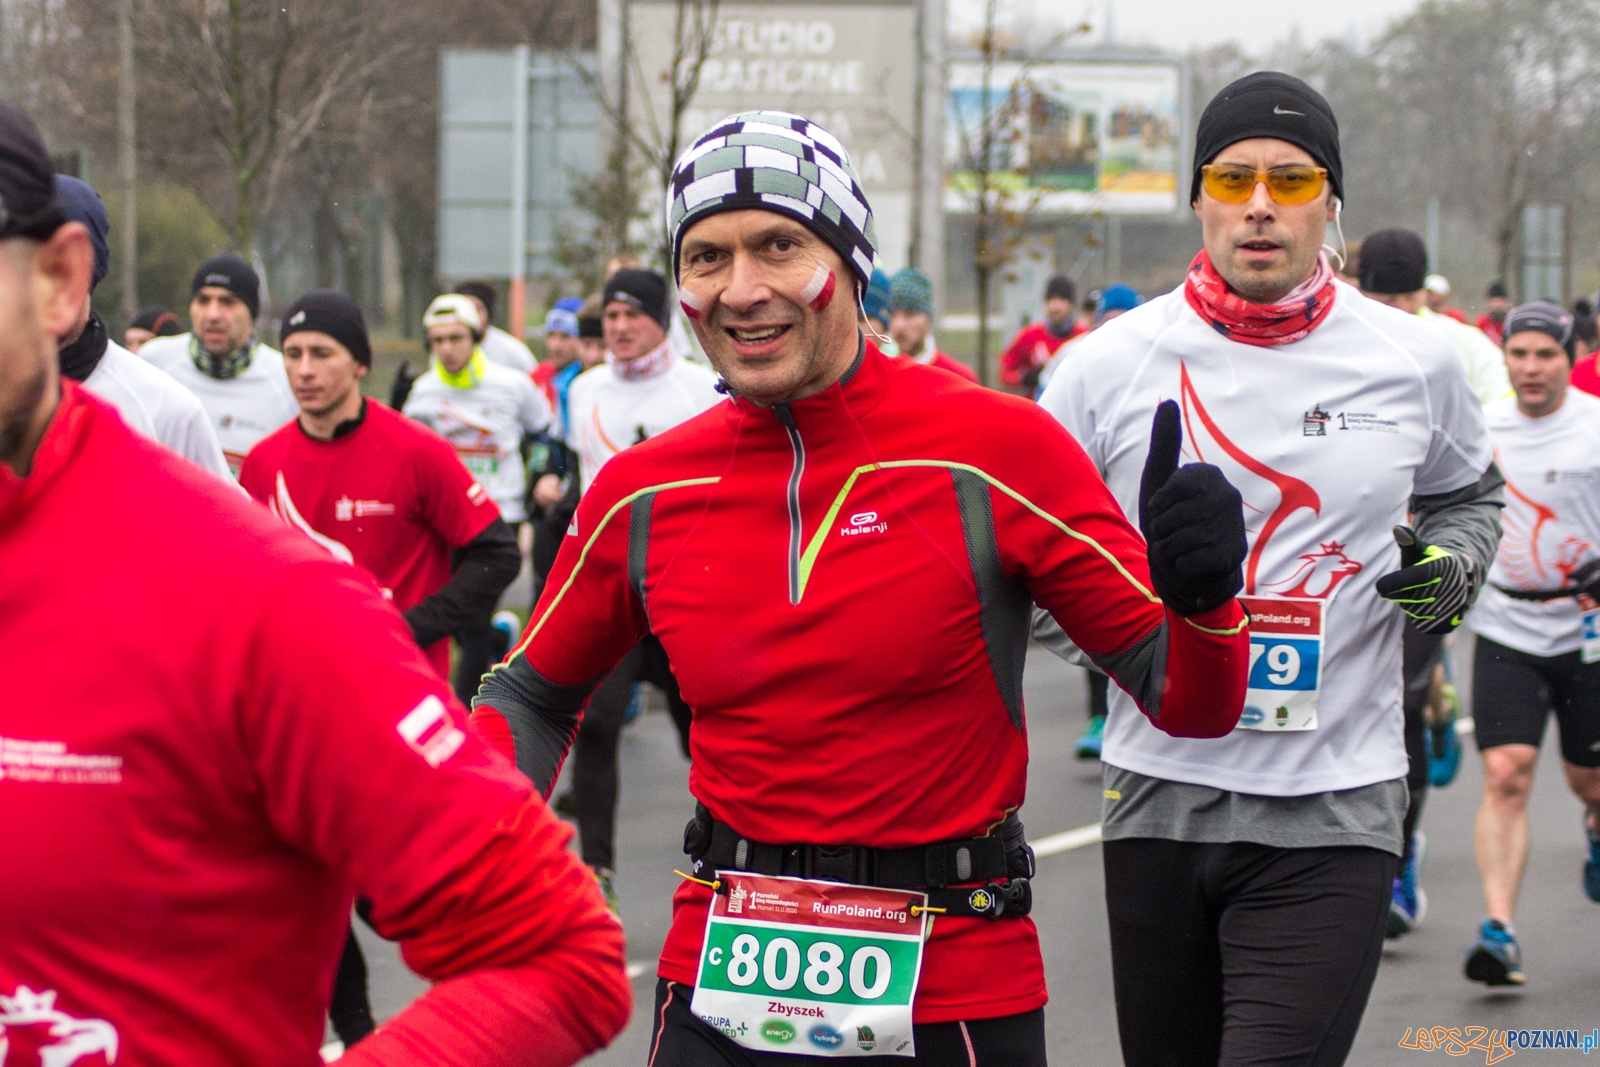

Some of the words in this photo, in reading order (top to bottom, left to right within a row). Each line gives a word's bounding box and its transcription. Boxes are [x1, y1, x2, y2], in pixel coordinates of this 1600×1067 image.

[711, 20, 835, 54] STUDIO
[1337, 412, 1349, 430] 1
[748, 891, 757, 909] 1
[813, 902, 907, 923] RunPoland.org
[726, 932, 893, 1001] 8080
[767, 1001, 825, 1018] Zbyszek
